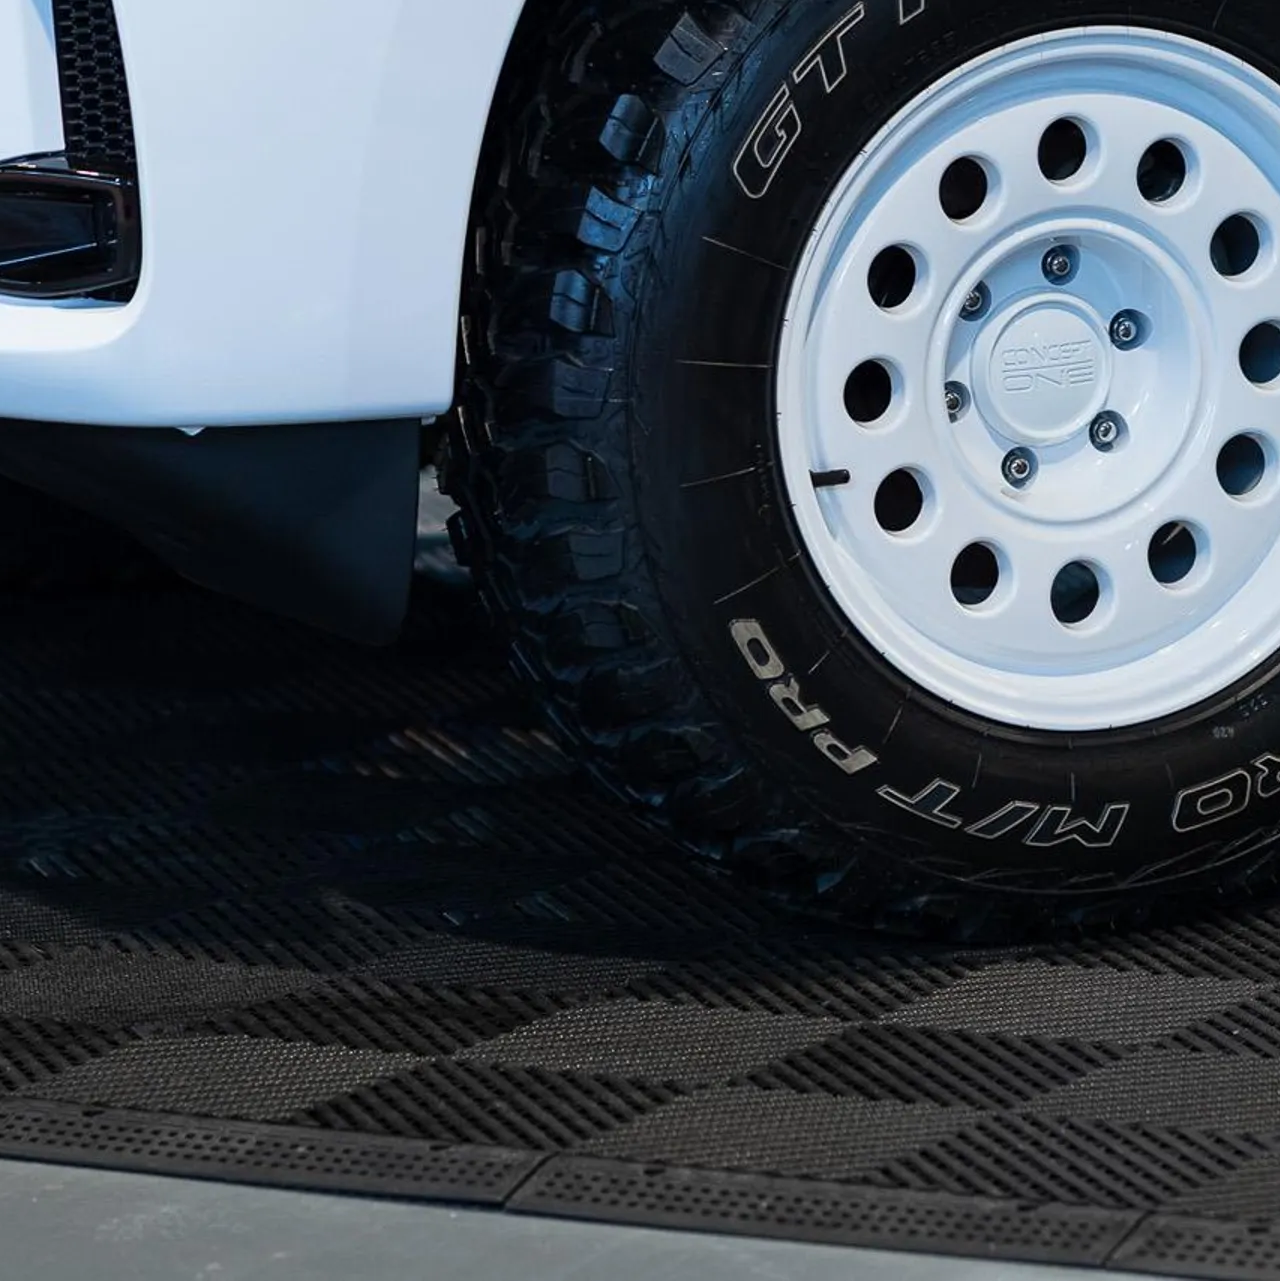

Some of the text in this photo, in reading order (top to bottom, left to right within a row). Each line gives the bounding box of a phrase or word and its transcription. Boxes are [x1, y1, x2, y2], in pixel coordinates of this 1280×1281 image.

[733, 1, 864, 199] GT
[729, 618, 878, 775] PRO
[877, 777, 1130, 847] M/T
